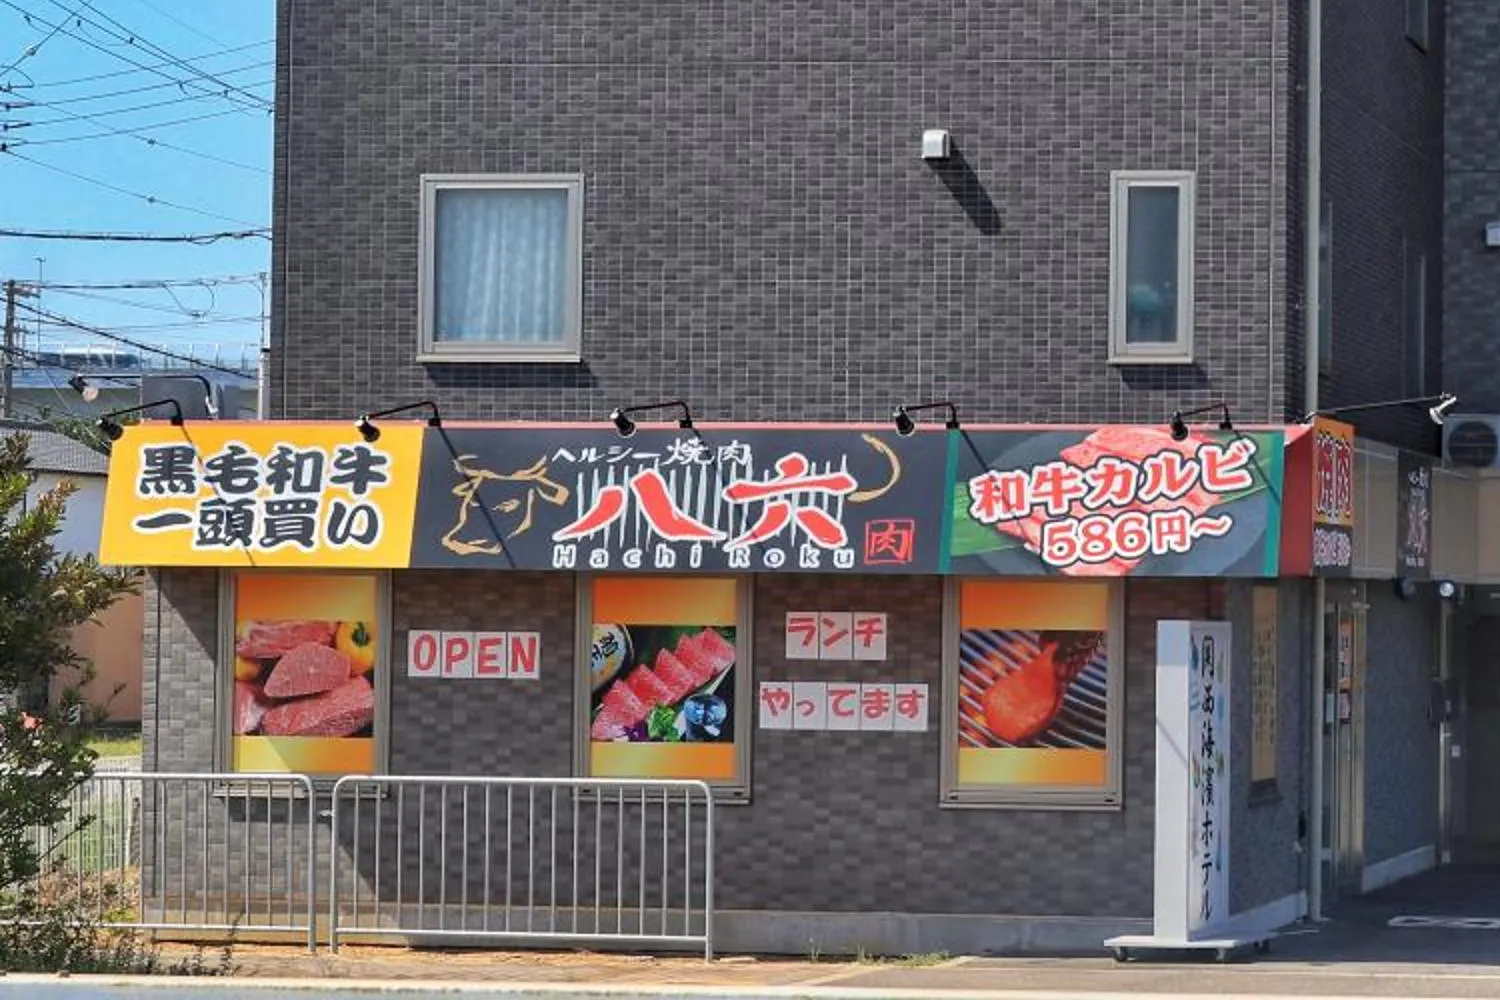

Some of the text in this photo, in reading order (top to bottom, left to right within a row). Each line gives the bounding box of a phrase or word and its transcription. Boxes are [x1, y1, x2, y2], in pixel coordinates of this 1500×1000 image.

[138, 443, 390, 496] 黒毛和牛
[552, 437, 752, 466] ヘルシー焼肉
[552, 453, 857, 551] 八六
[970, 438, 1258, 524] 和牛カルビ
[136, 499, 381, 548] 一頭買い
[552, 544, 855, 569] Hachi Roku
[786, 616, 886, 647] ランチ
[413, 632, 539, 675] OPEN
[762, 685, 926, 716] やってます
